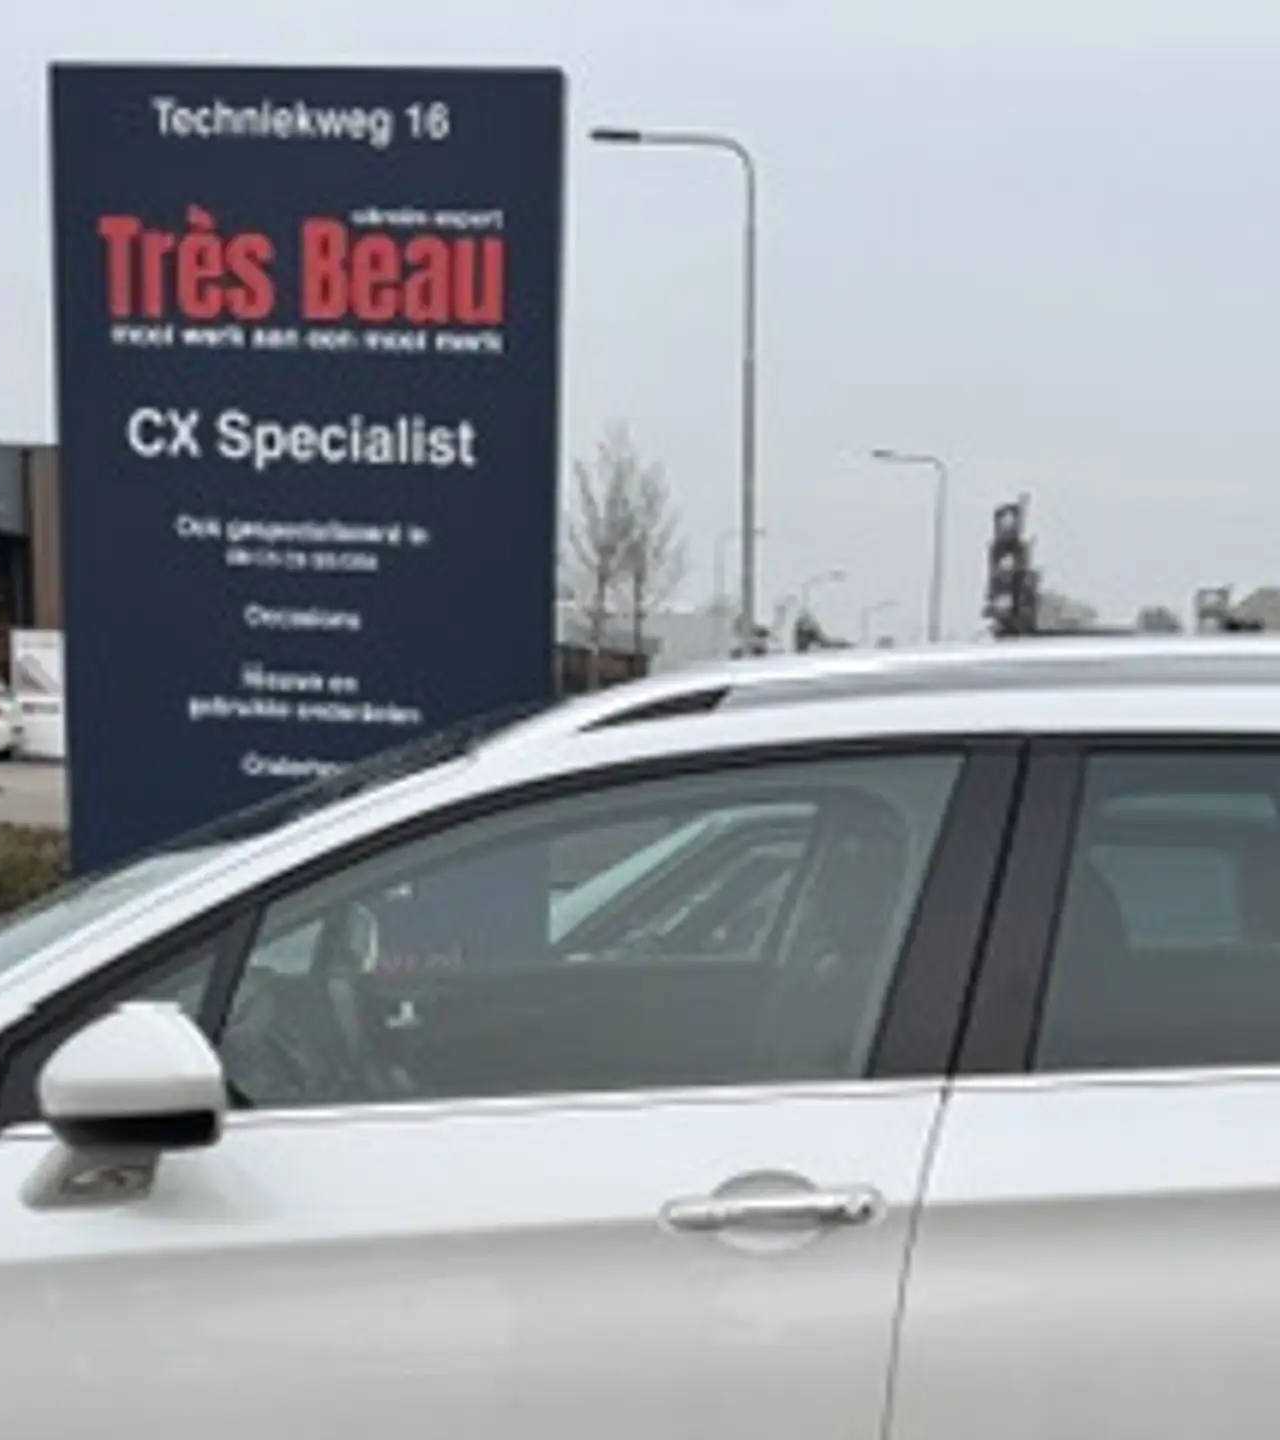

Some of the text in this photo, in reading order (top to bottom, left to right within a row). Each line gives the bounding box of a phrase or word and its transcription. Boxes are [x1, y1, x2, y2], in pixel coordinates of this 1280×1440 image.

[153, 97, 450, 150] Techniekweg 16
[98, 205, 506, 325] Très Beau
[125, 407, 476, 470] CX Specialist
